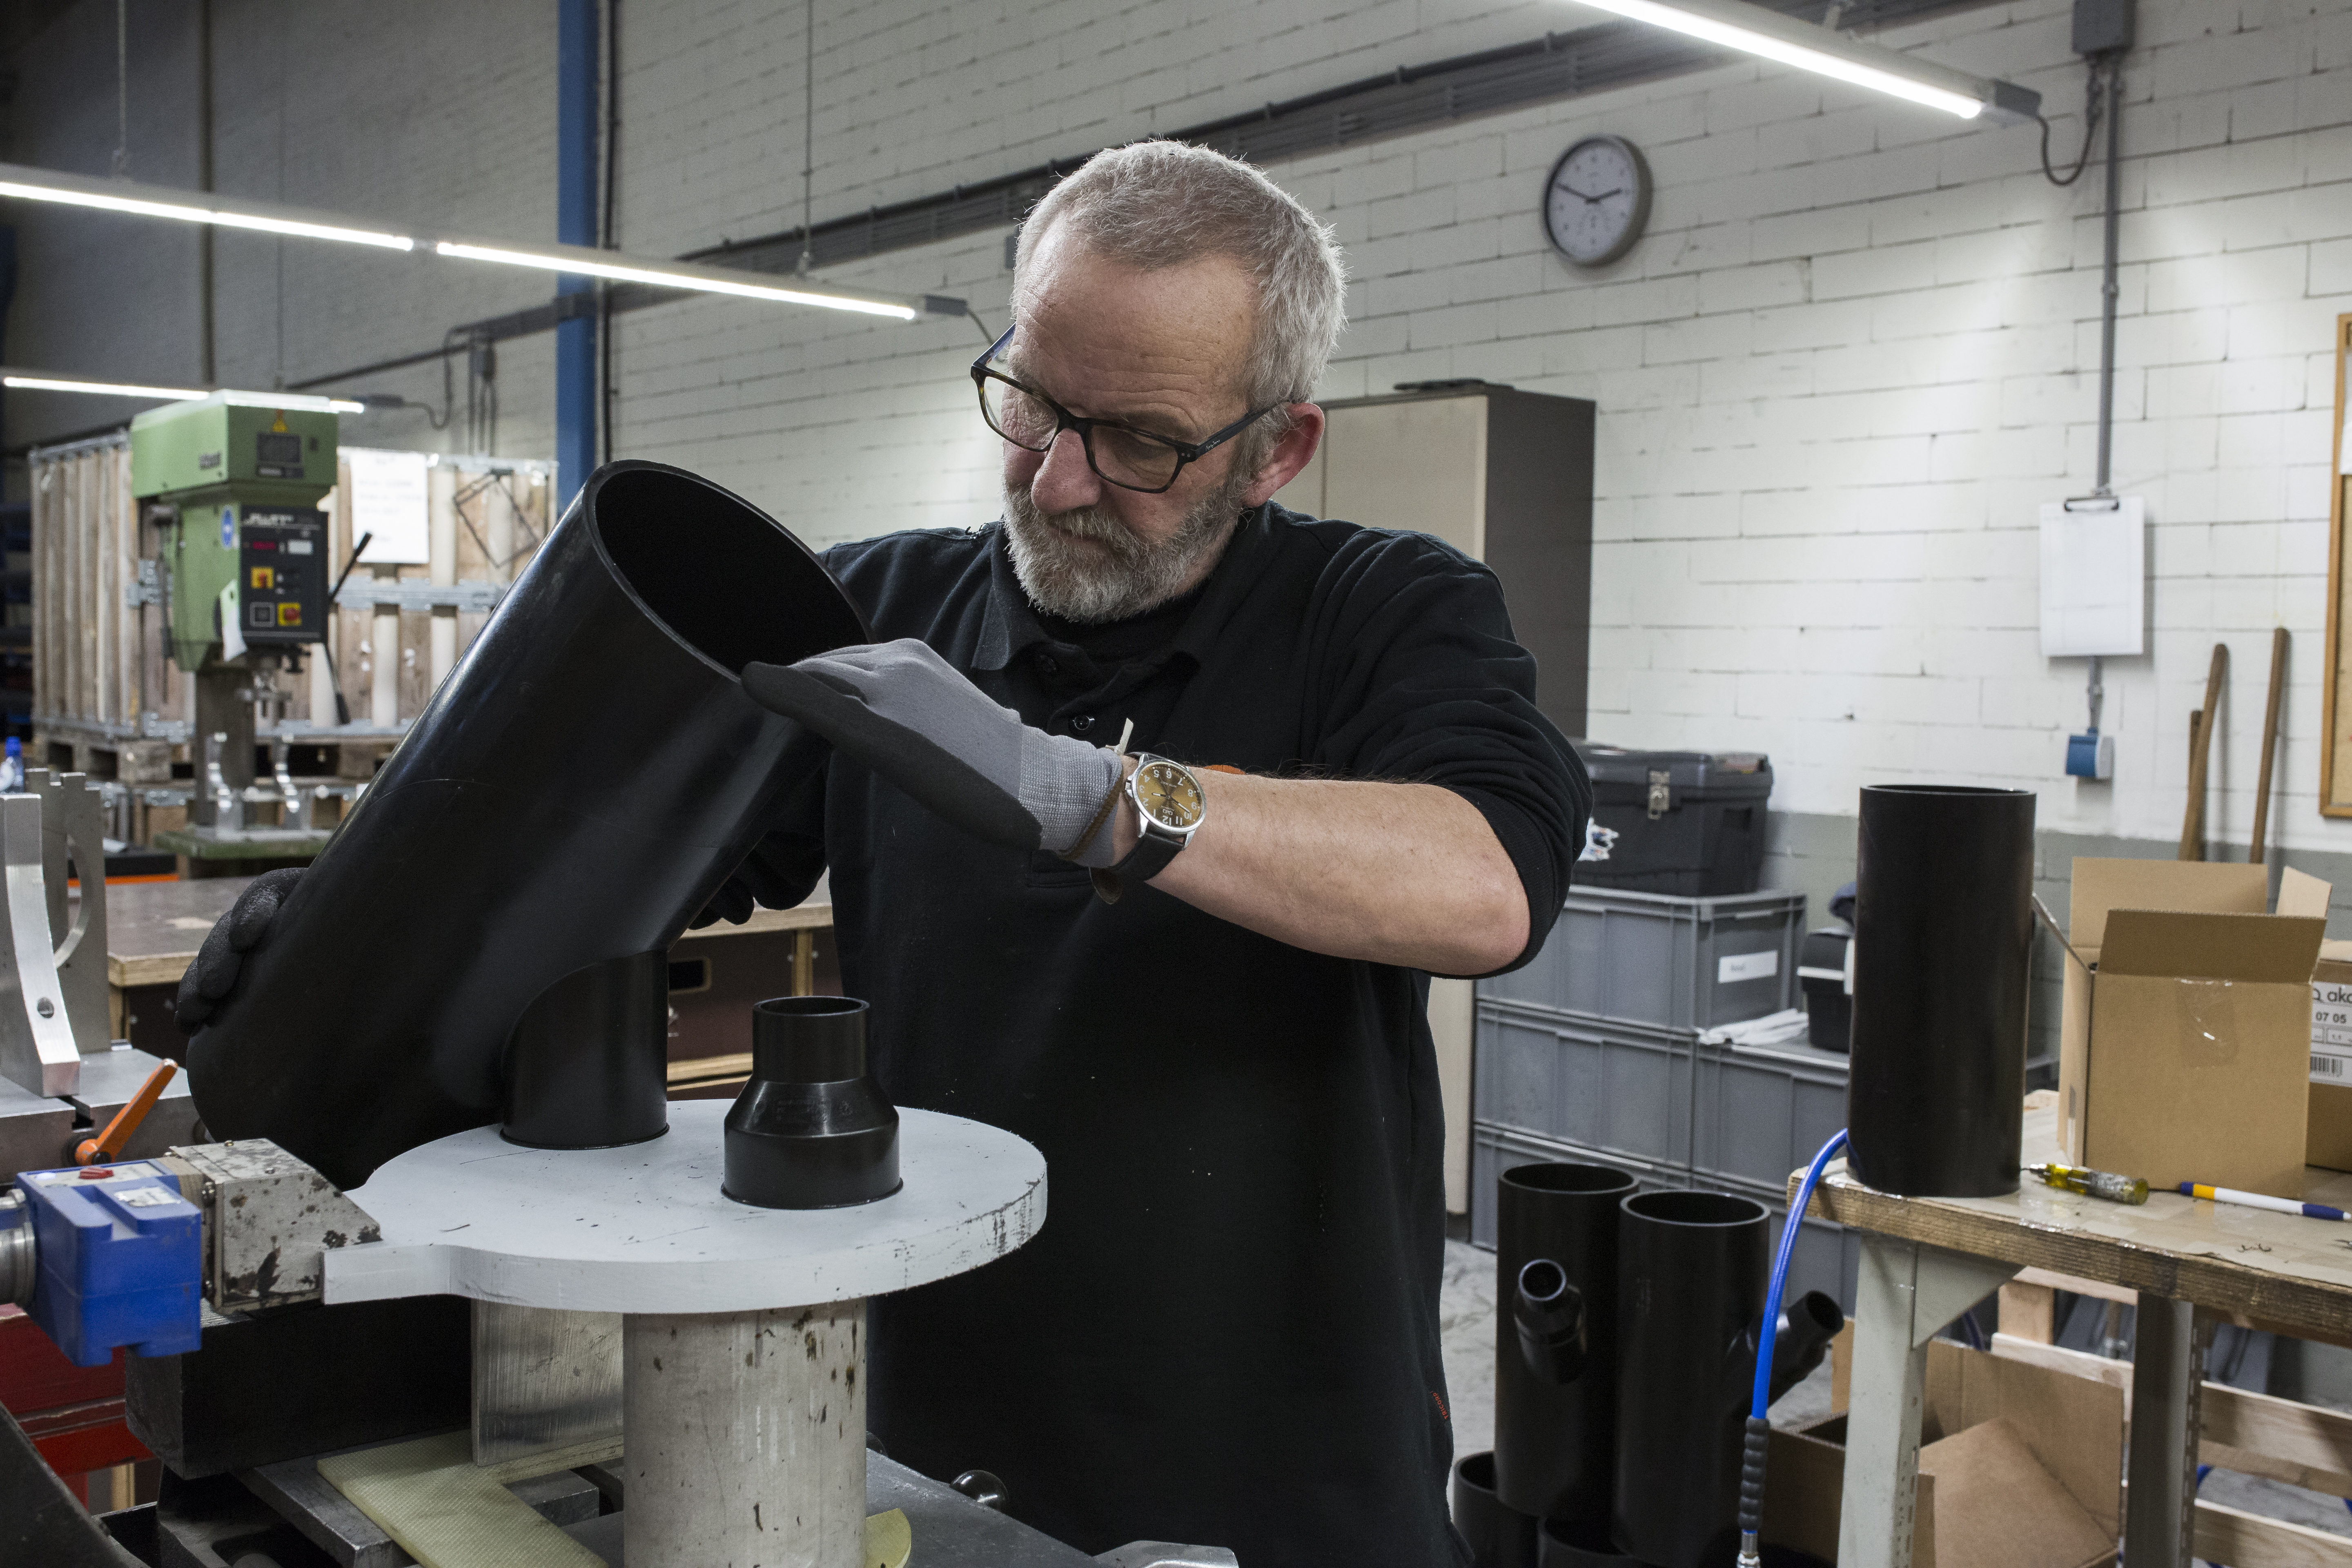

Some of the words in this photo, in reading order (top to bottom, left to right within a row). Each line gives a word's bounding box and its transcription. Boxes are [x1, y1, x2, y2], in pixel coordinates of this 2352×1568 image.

[1154, 770, 1159, 778] 5
[1166, 770, 1172, 779] 6
[1144, 775, 1150, 783] 4
[1178, 777, 1183, 786] 7
[1139, 784, 1145, 793] 3
[1188, 789, 1193, 797] 8
[1143, 797, 1149, 806] 2
[1191, 802, 1197, 810] 9
[1153, 809, 1156, 817] 1
[1184, 811, 1192, 820] 10
[1162, 815, 1172, 826] 12
[1176, 816, 1183, 825] 11
[2316, 1011, 2329, 1021] 07
[1432, 1392, 1448, 1419] TRICORP
